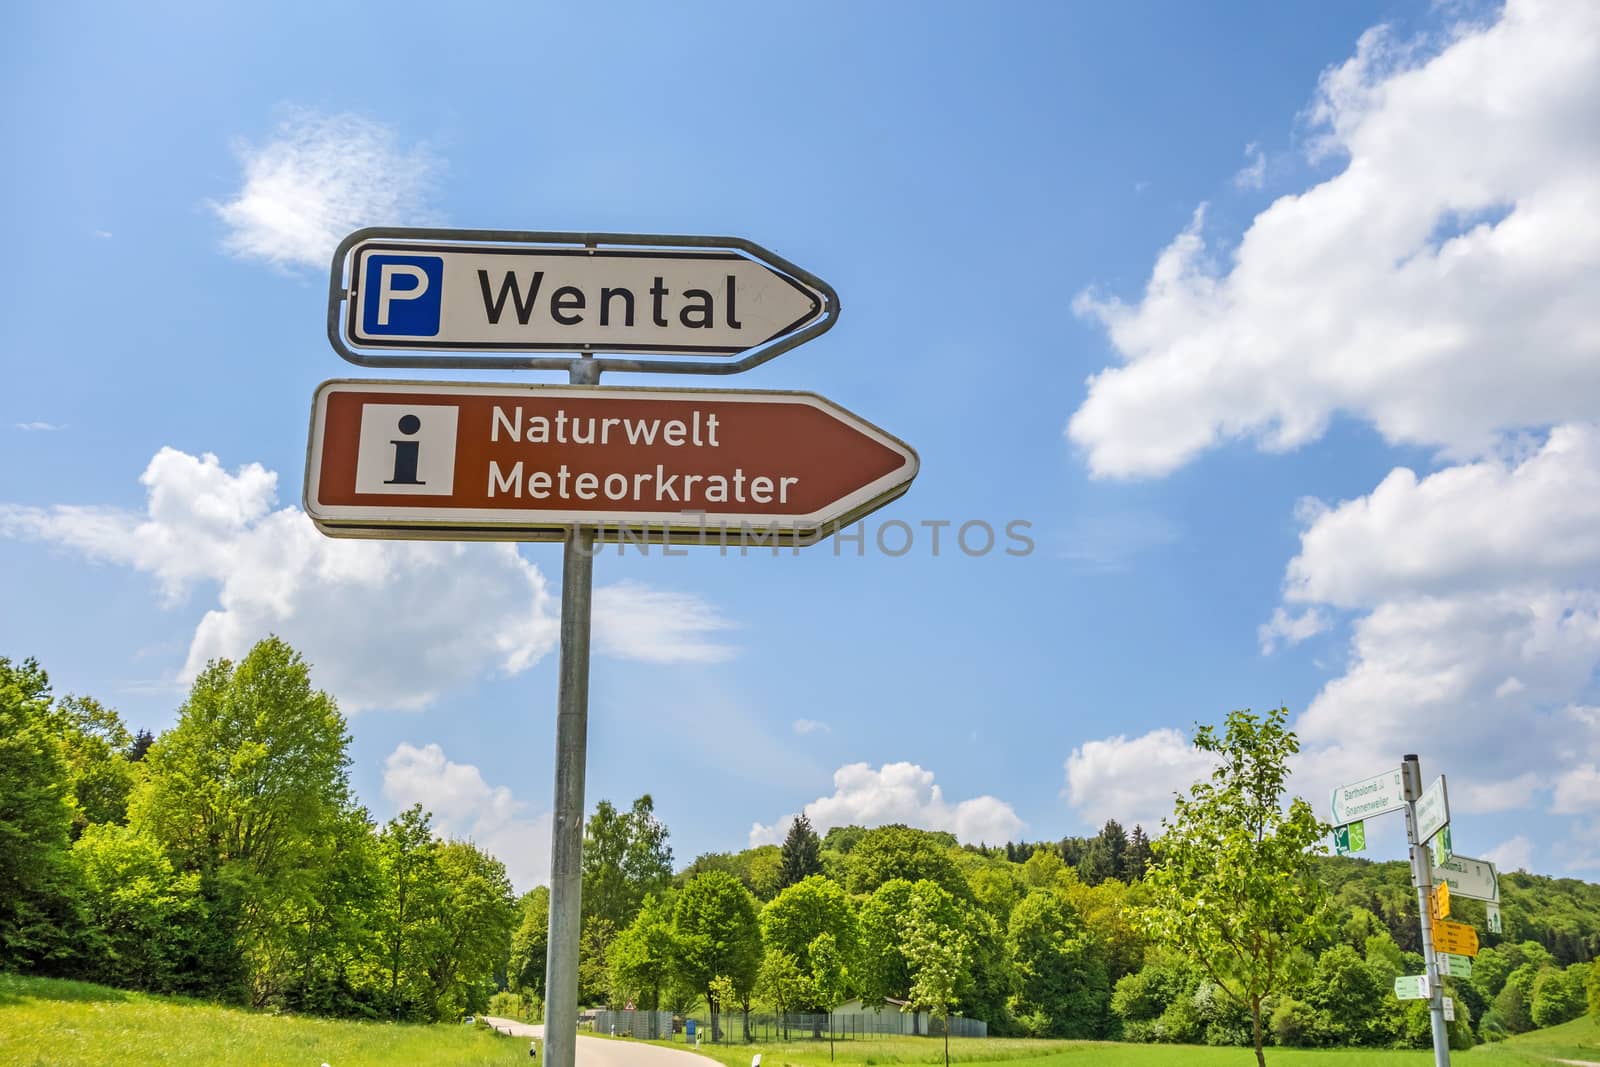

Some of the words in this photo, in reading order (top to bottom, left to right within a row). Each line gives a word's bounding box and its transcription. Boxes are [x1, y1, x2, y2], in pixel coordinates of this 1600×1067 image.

[377, 263, 430, 326] P
[477, 269, 742, 330] Wental
[490, 405, 720, 447] Naturwelt
[486, 460, 799, 504] Meteorkrater
[1344, 781, 1377, 801] Bartholomä
